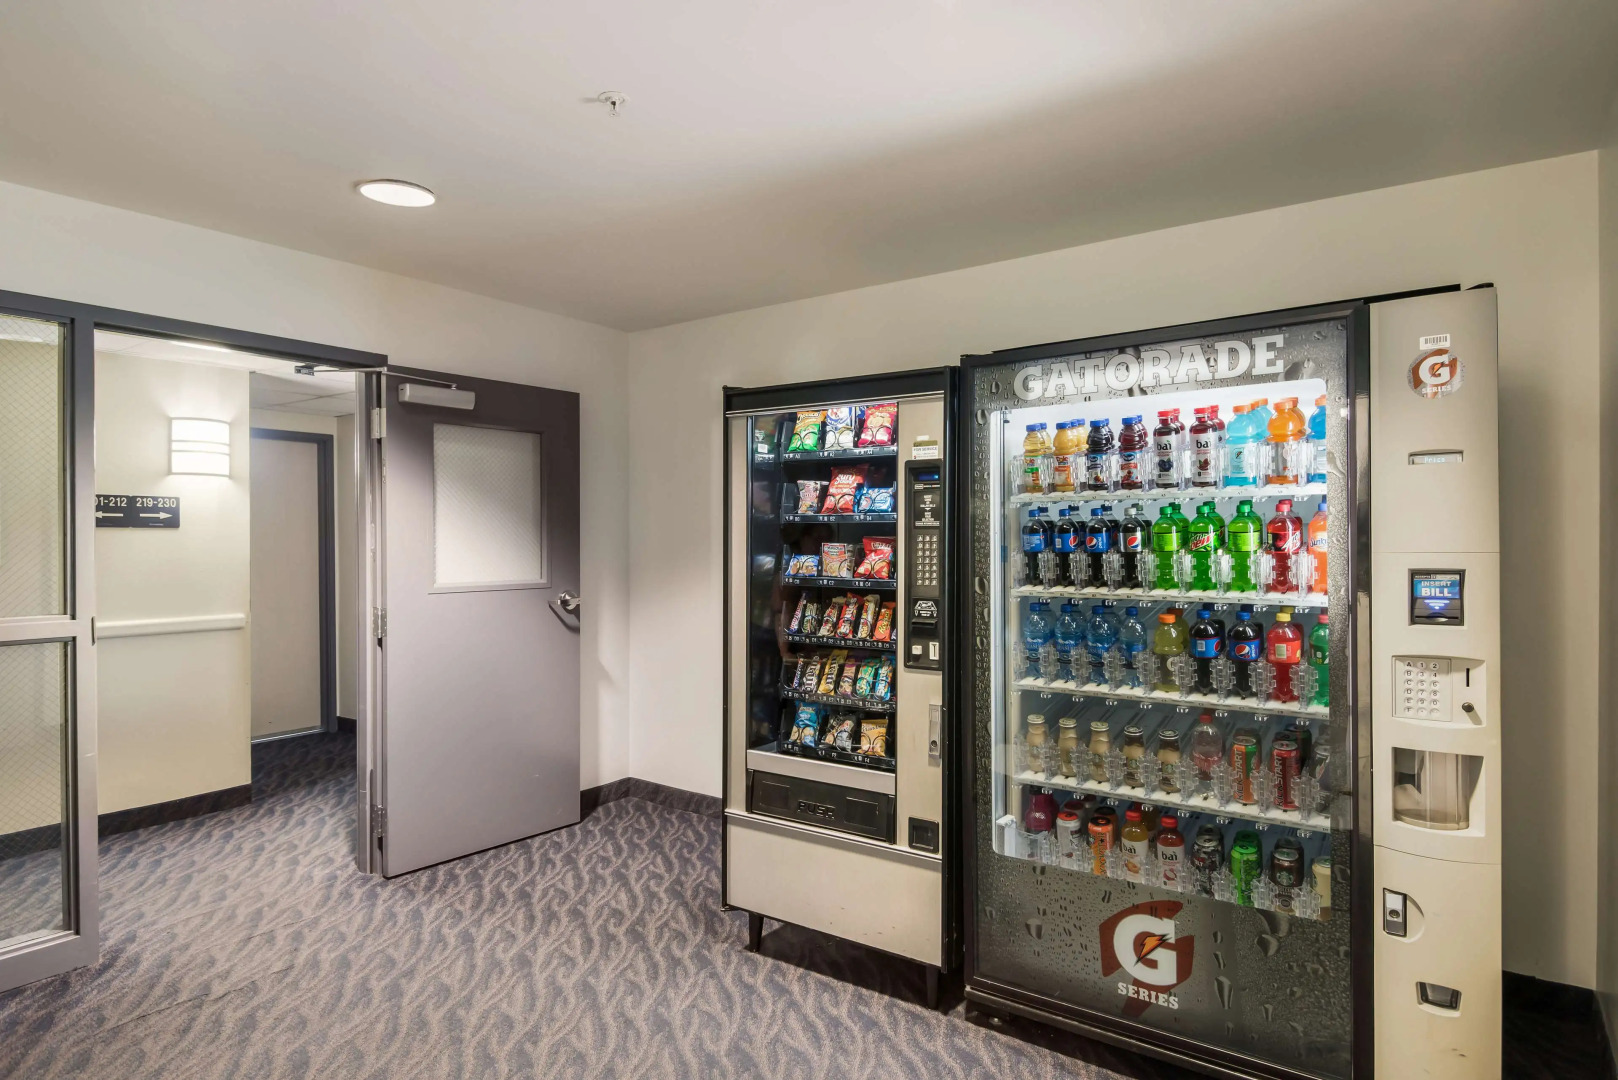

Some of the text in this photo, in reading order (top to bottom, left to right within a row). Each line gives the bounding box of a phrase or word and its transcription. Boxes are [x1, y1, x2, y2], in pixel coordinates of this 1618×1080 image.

[1013, 334, 1284, 400] GATORADE
[1421, 385, 1452, 394] SERIES
[136, 497, 177, 508] 219-230
[1421, 587, 1452, 597] BILL
[1234, 750, 1244, 800] KICKSTART
[1161, 850, 1178, 861] bai
[1117, 982, 1179, 1010] SERIES
